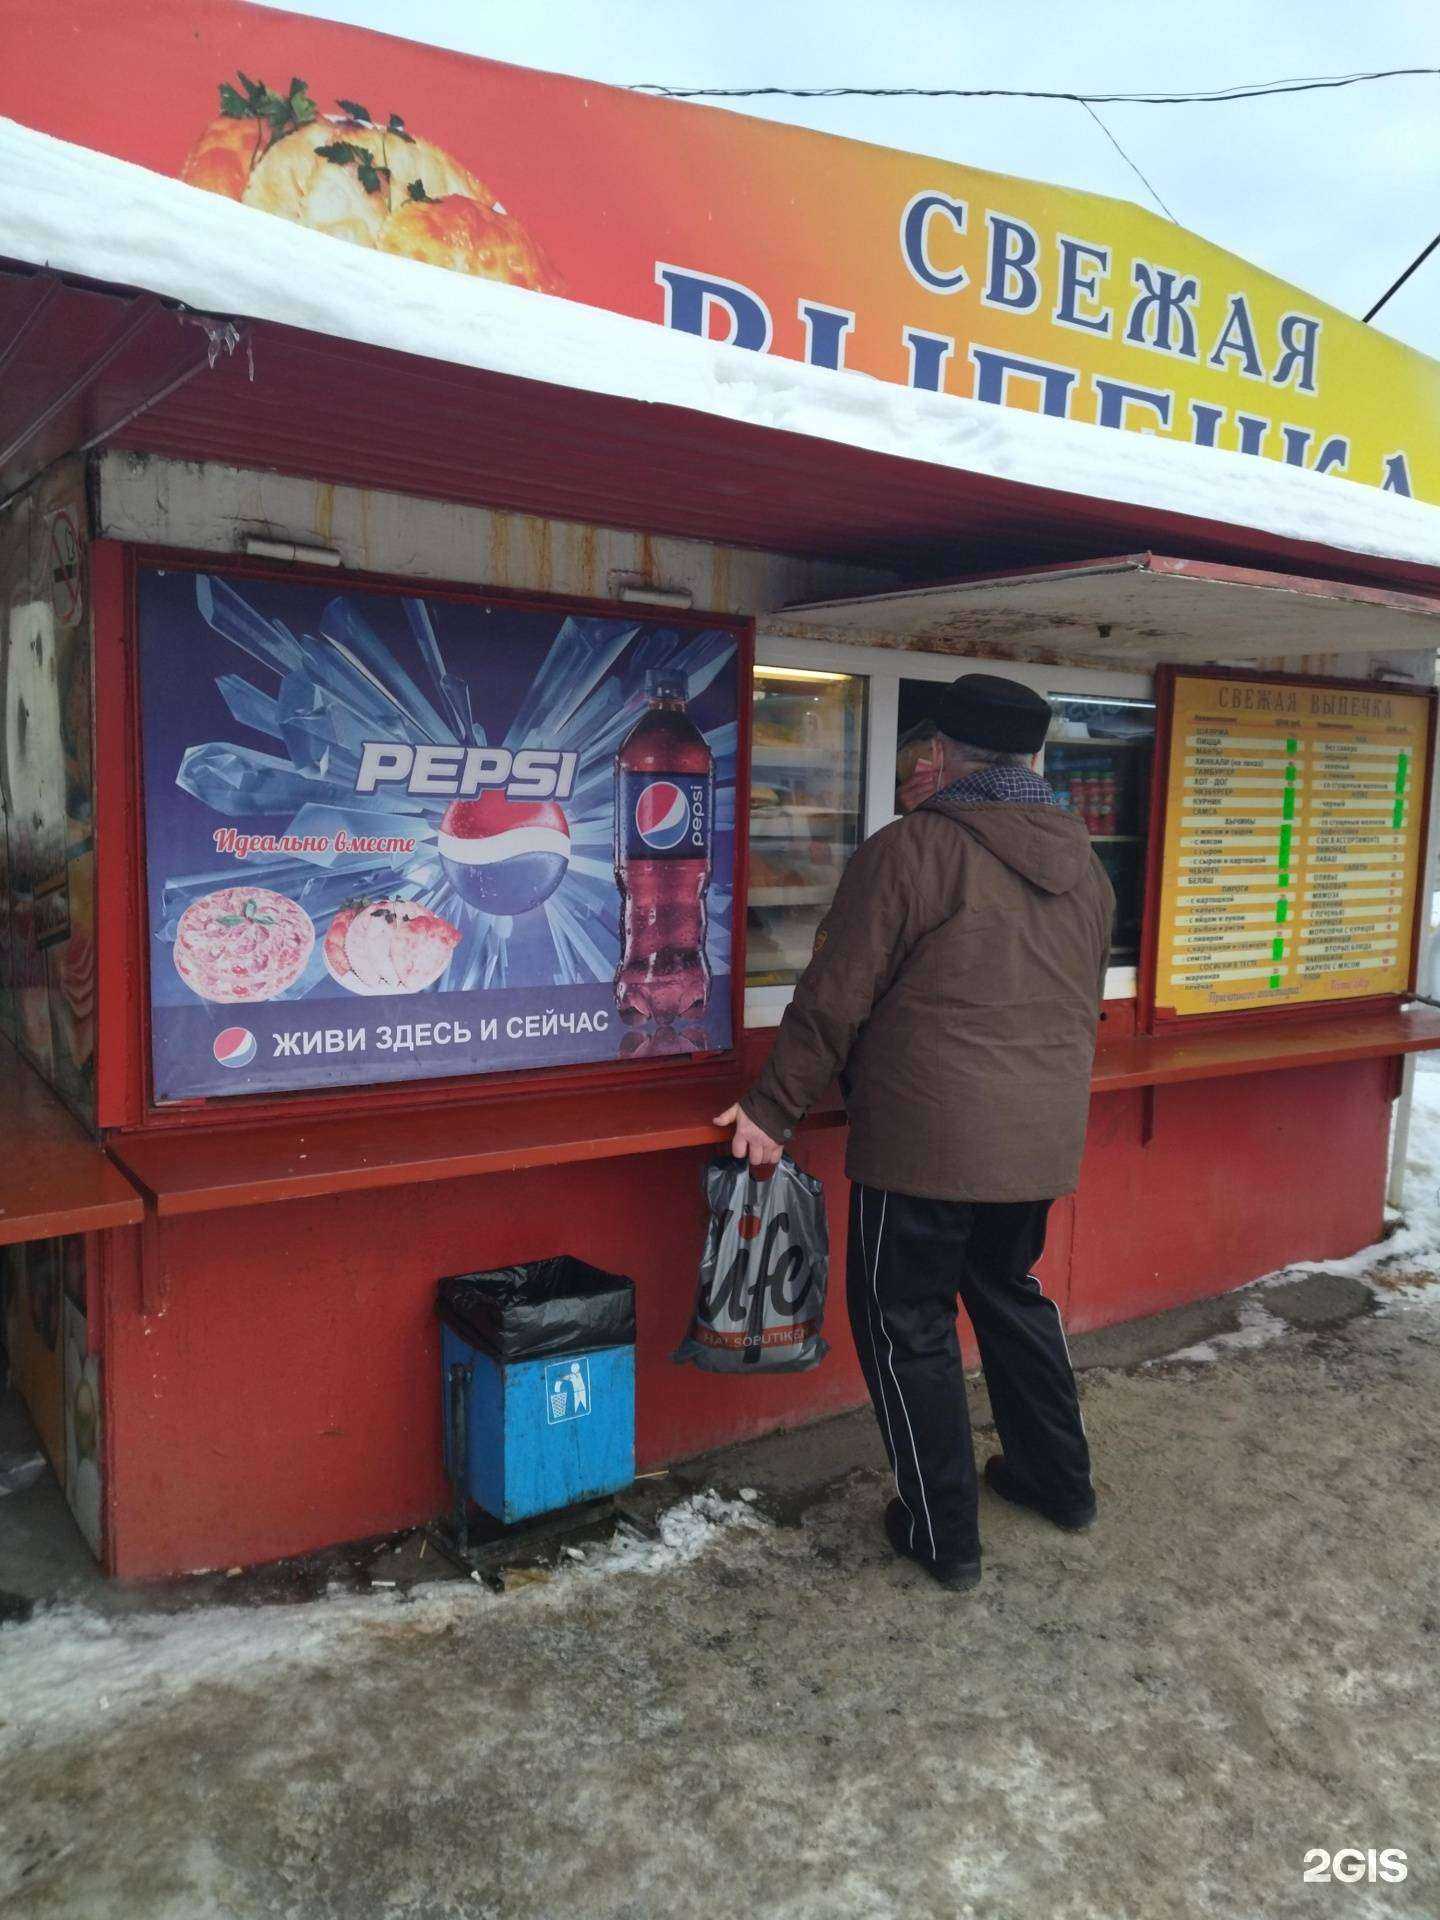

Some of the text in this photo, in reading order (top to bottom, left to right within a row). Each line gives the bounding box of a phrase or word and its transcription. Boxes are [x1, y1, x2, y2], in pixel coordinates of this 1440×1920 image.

[901, 191, 1320, 395] СВЕЖАЯ
[1219, 687, 1392, 719] СВЕЖАЯ ВЫПЕЧКА
[355, 742, 579, 798] PEPSI
[691, 785, 704, 847] pepsi
[214, 828, 415, 858] Идеально вместе
[272, 1009, 609, 1057] ЖИВИ ЗДЕСЬ И СЕЙЧАС
